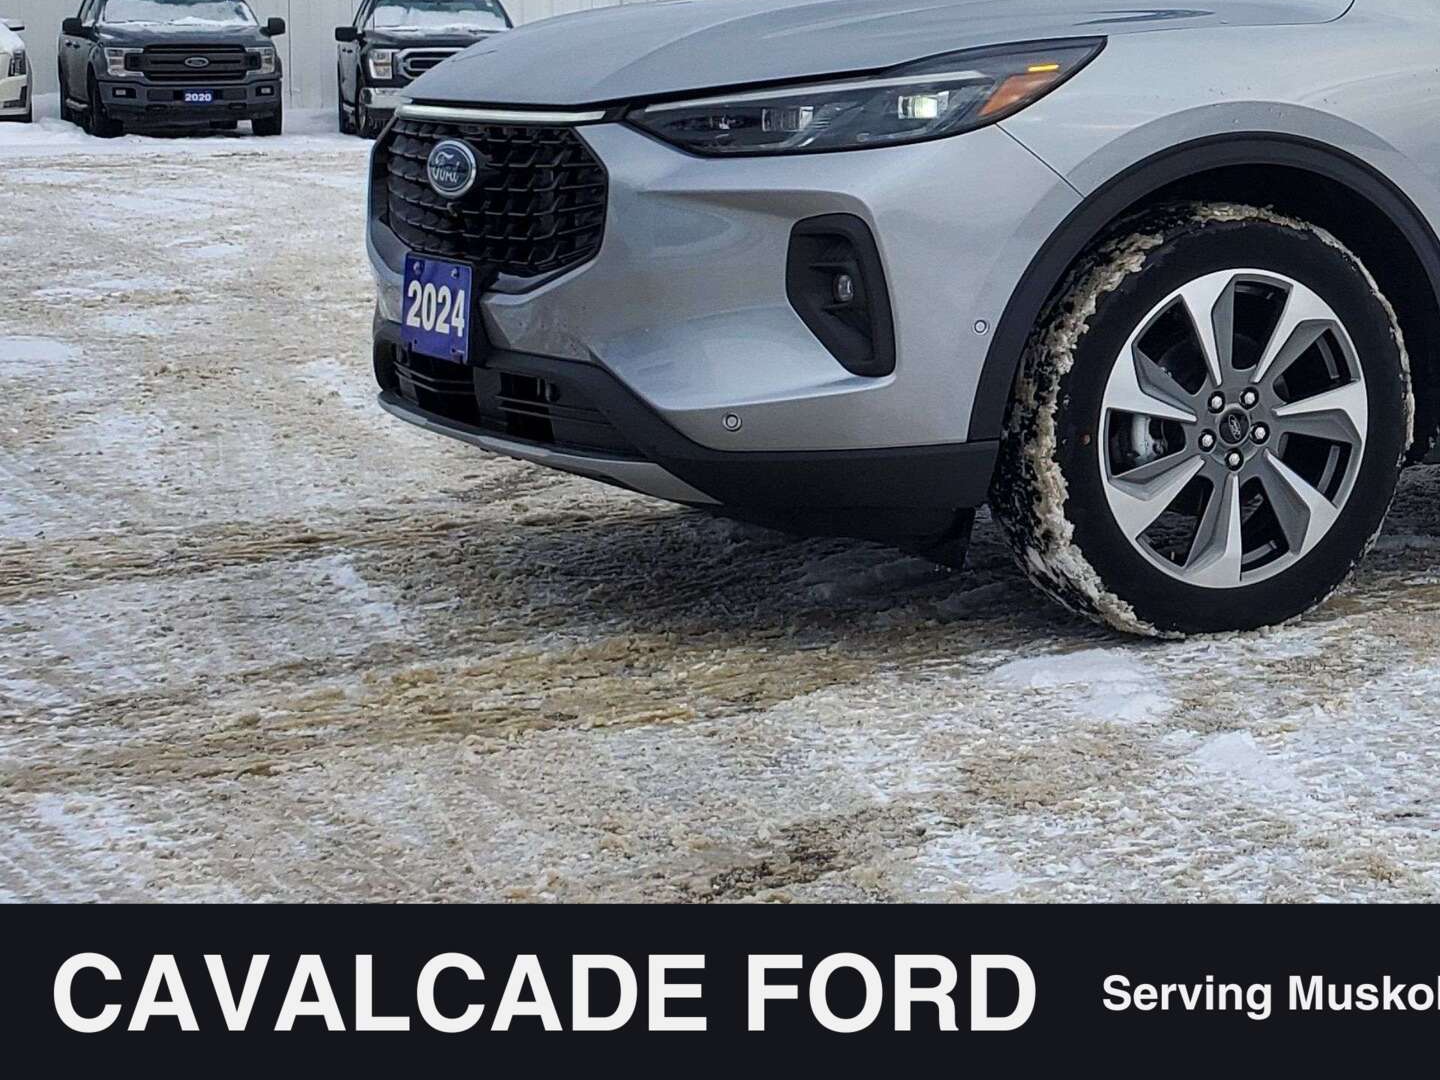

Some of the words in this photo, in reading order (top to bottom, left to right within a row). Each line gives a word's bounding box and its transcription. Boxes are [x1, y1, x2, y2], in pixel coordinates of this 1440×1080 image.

[184, 93, 212, 101] 2020
[432, 151, 461, 184] Ford
[406, 279, 466, 338] 2024
